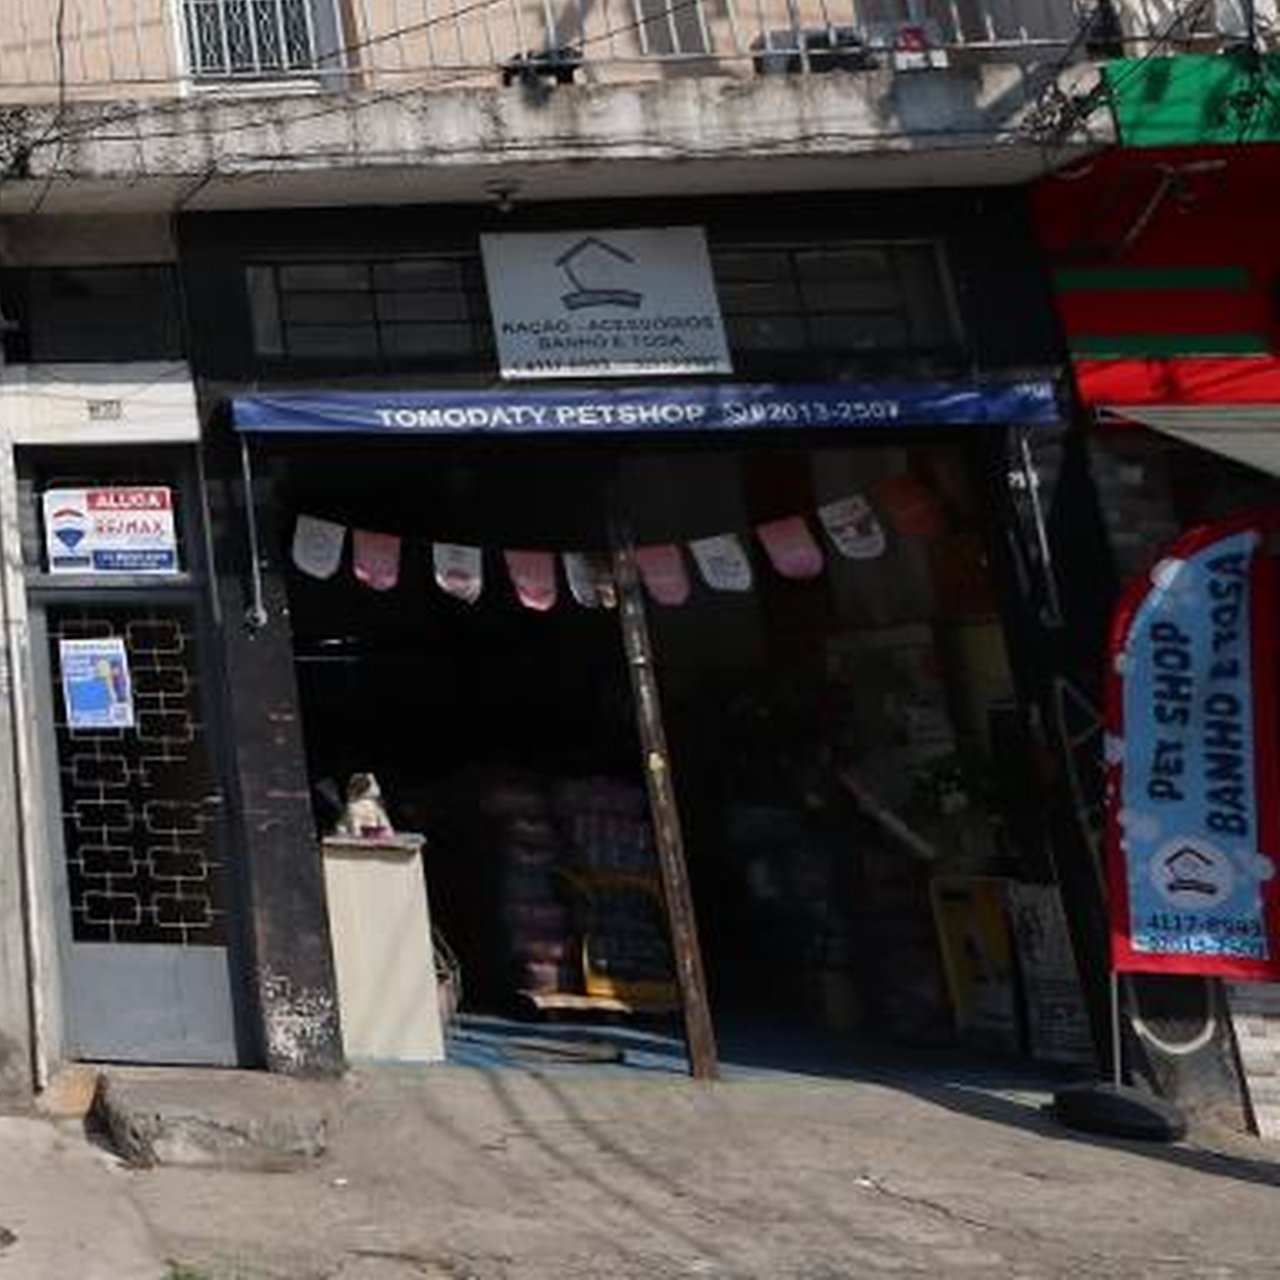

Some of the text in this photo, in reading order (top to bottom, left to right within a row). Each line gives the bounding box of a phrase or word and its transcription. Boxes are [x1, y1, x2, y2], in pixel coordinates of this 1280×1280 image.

[375, 405, 546, 428] TOMODATY
[1205, 552, 1247, 653] TOSA
[1149, 621, 1192, 726] SHOP
[1203, 692, 1248, 837] BANHO
